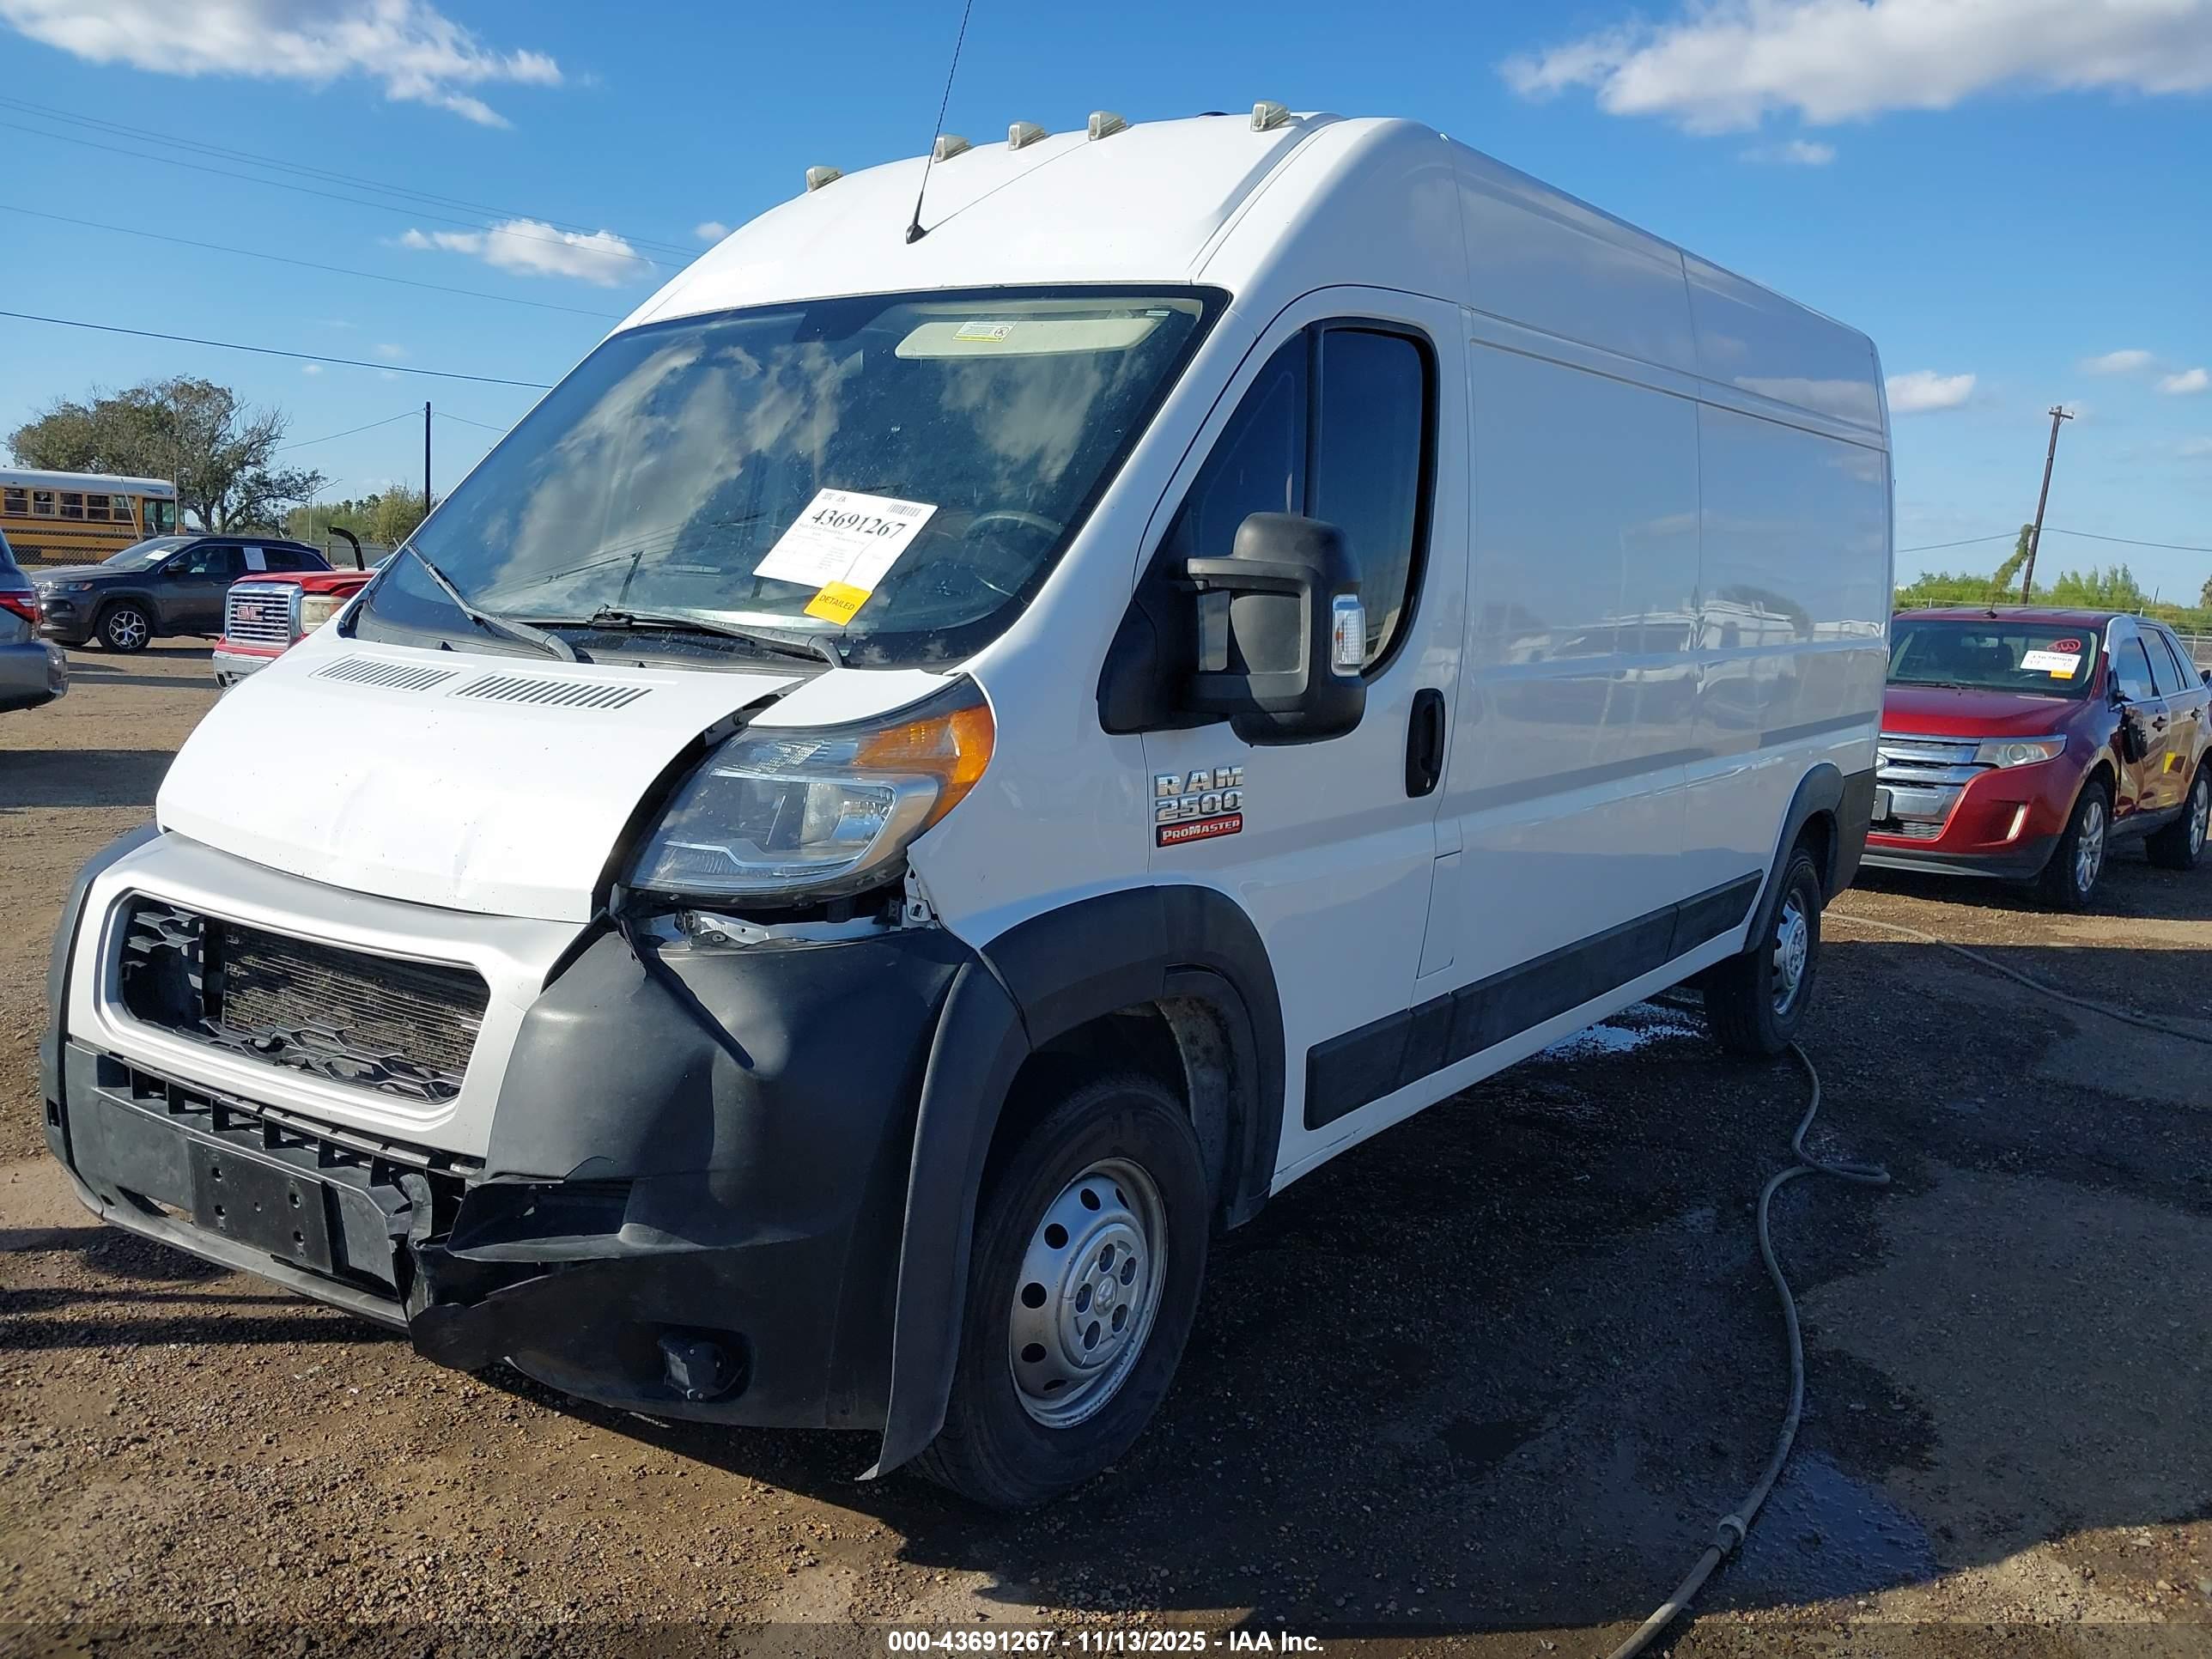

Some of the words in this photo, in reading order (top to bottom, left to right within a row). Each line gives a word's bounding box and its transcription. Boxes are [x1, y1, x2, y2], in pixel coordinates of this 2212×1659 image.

[811, 508, 907, 538] 43691267
[237, 605, 264, 621] GMC
[819, 594, 855, 611] DETAILED
[1154, 766, 1243, 797] RAM
[1155, 789, 1243, 823] 2500
